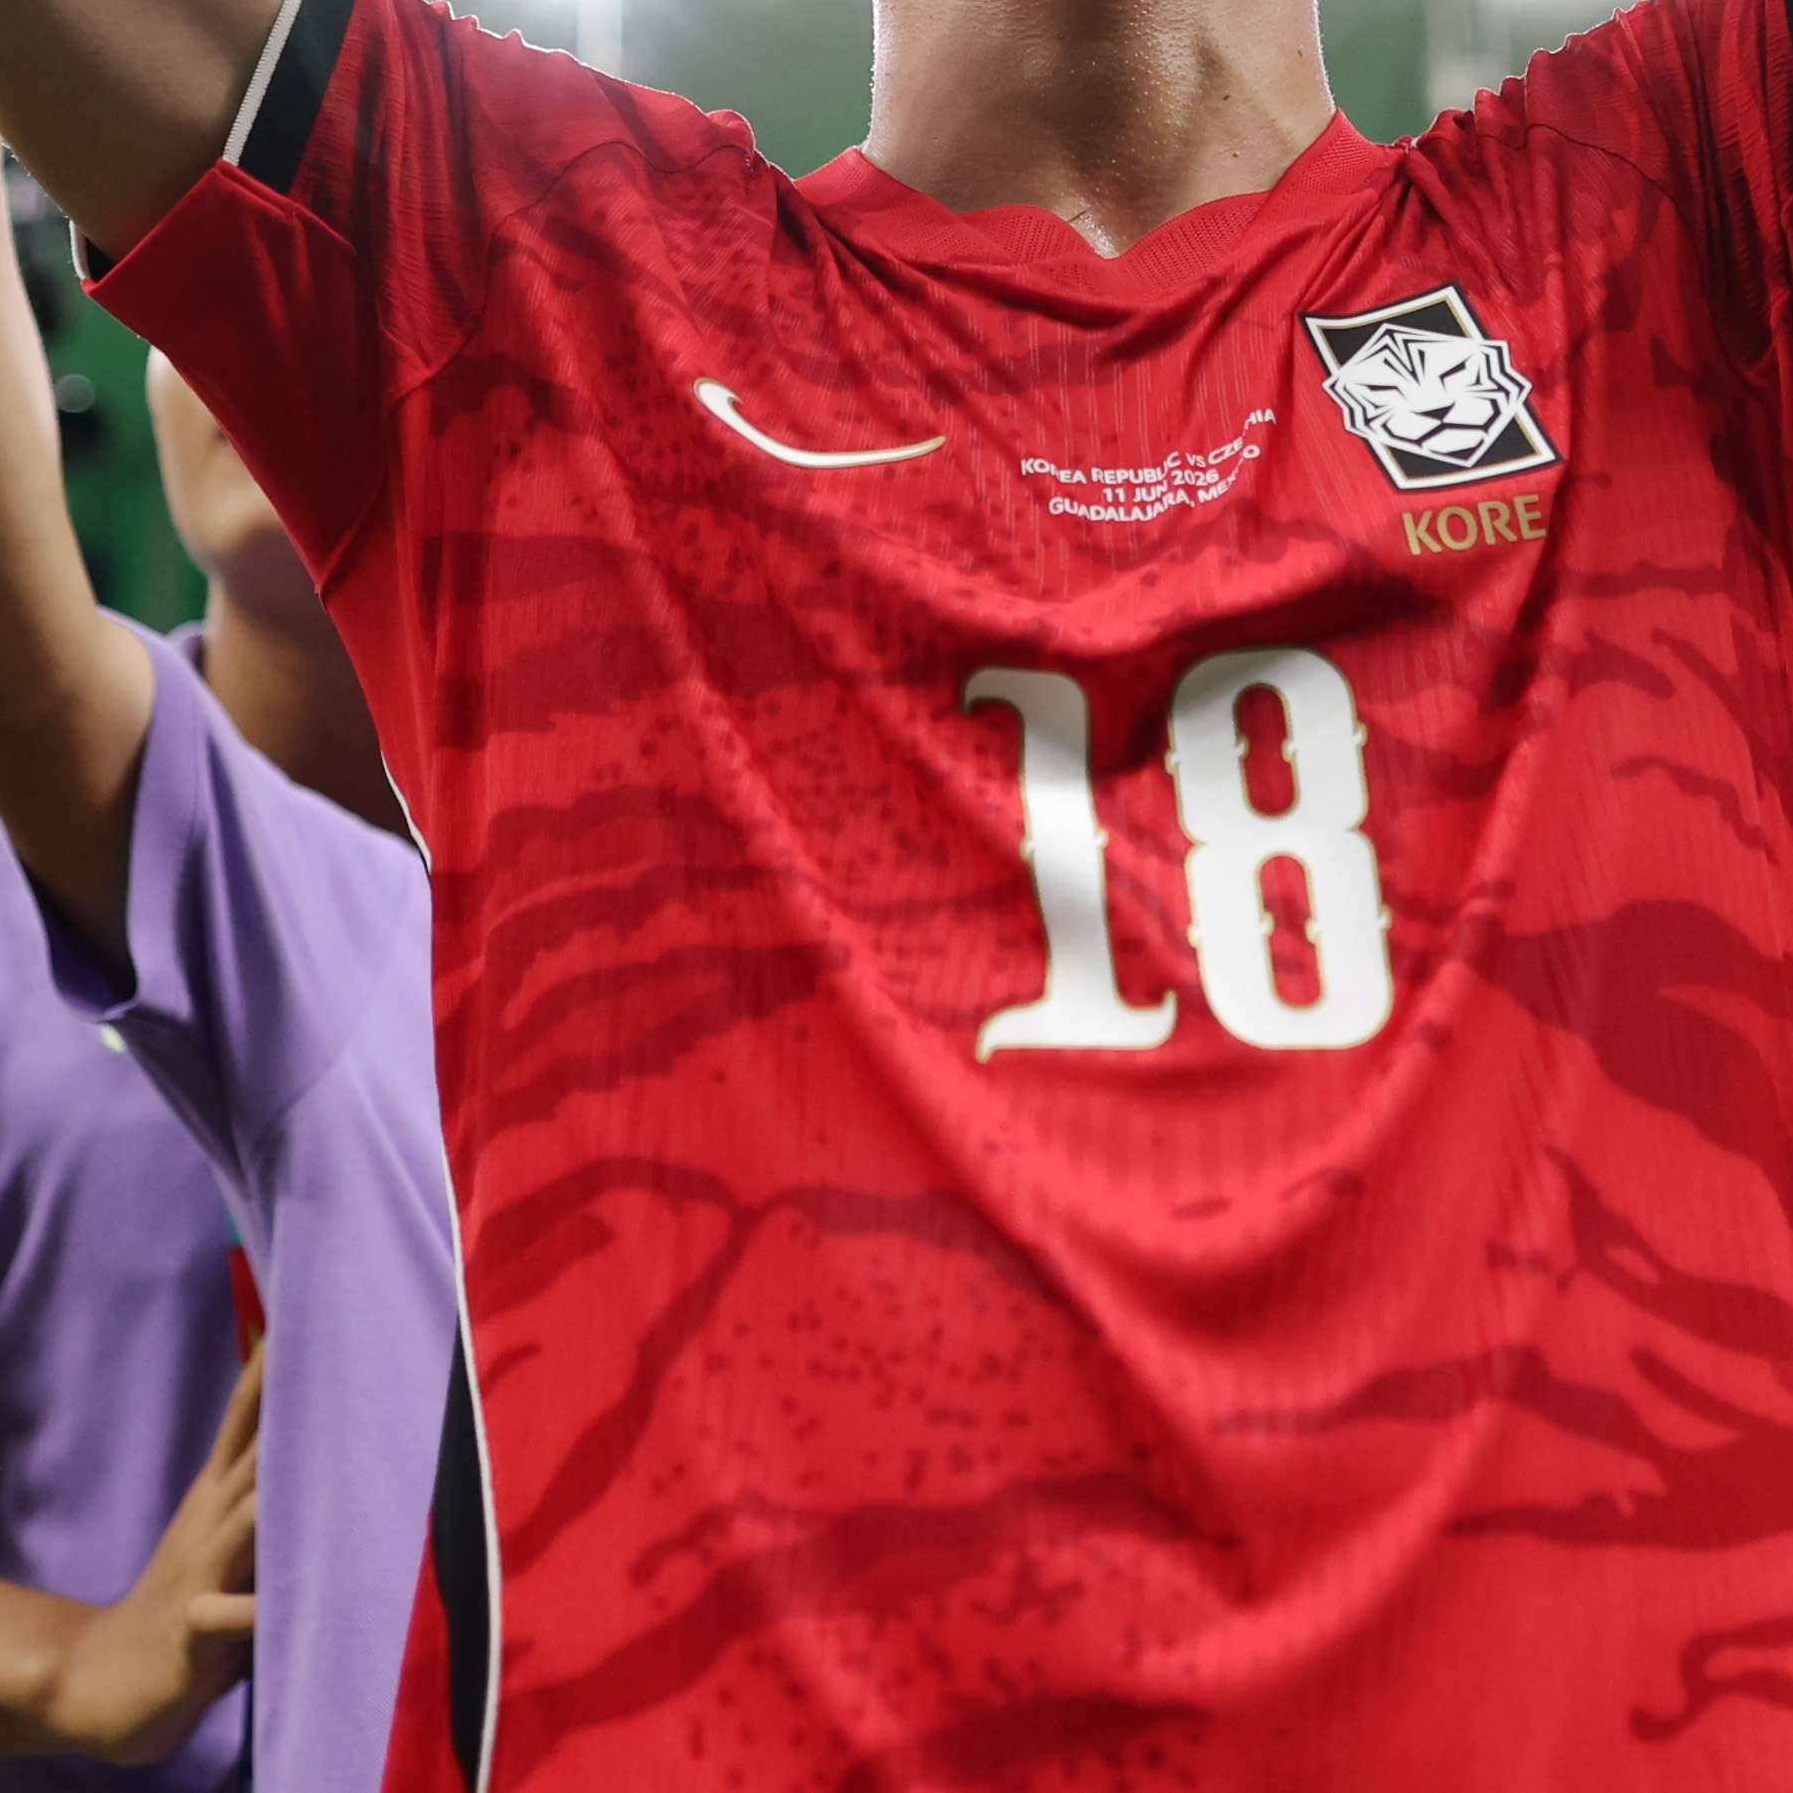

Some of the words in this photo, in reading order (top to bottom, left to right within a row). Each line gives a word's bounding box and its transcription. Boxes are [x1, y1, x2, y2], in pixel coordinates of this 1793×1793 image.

[1090, 450, 1182, 485] REPUBLIC
[1185, 451, 1207, 468] VS
[1207, 407, 1277, 466] CZEHIA
[1048, 488, 1196, 522] GUADALAJARA,
[1102, 486, 1126, 503] 11
[1132, 479, 1169, 503] JUN
[1170, 467, 1221, 487] 2026
[962, 645, 1393, 1064] 18
